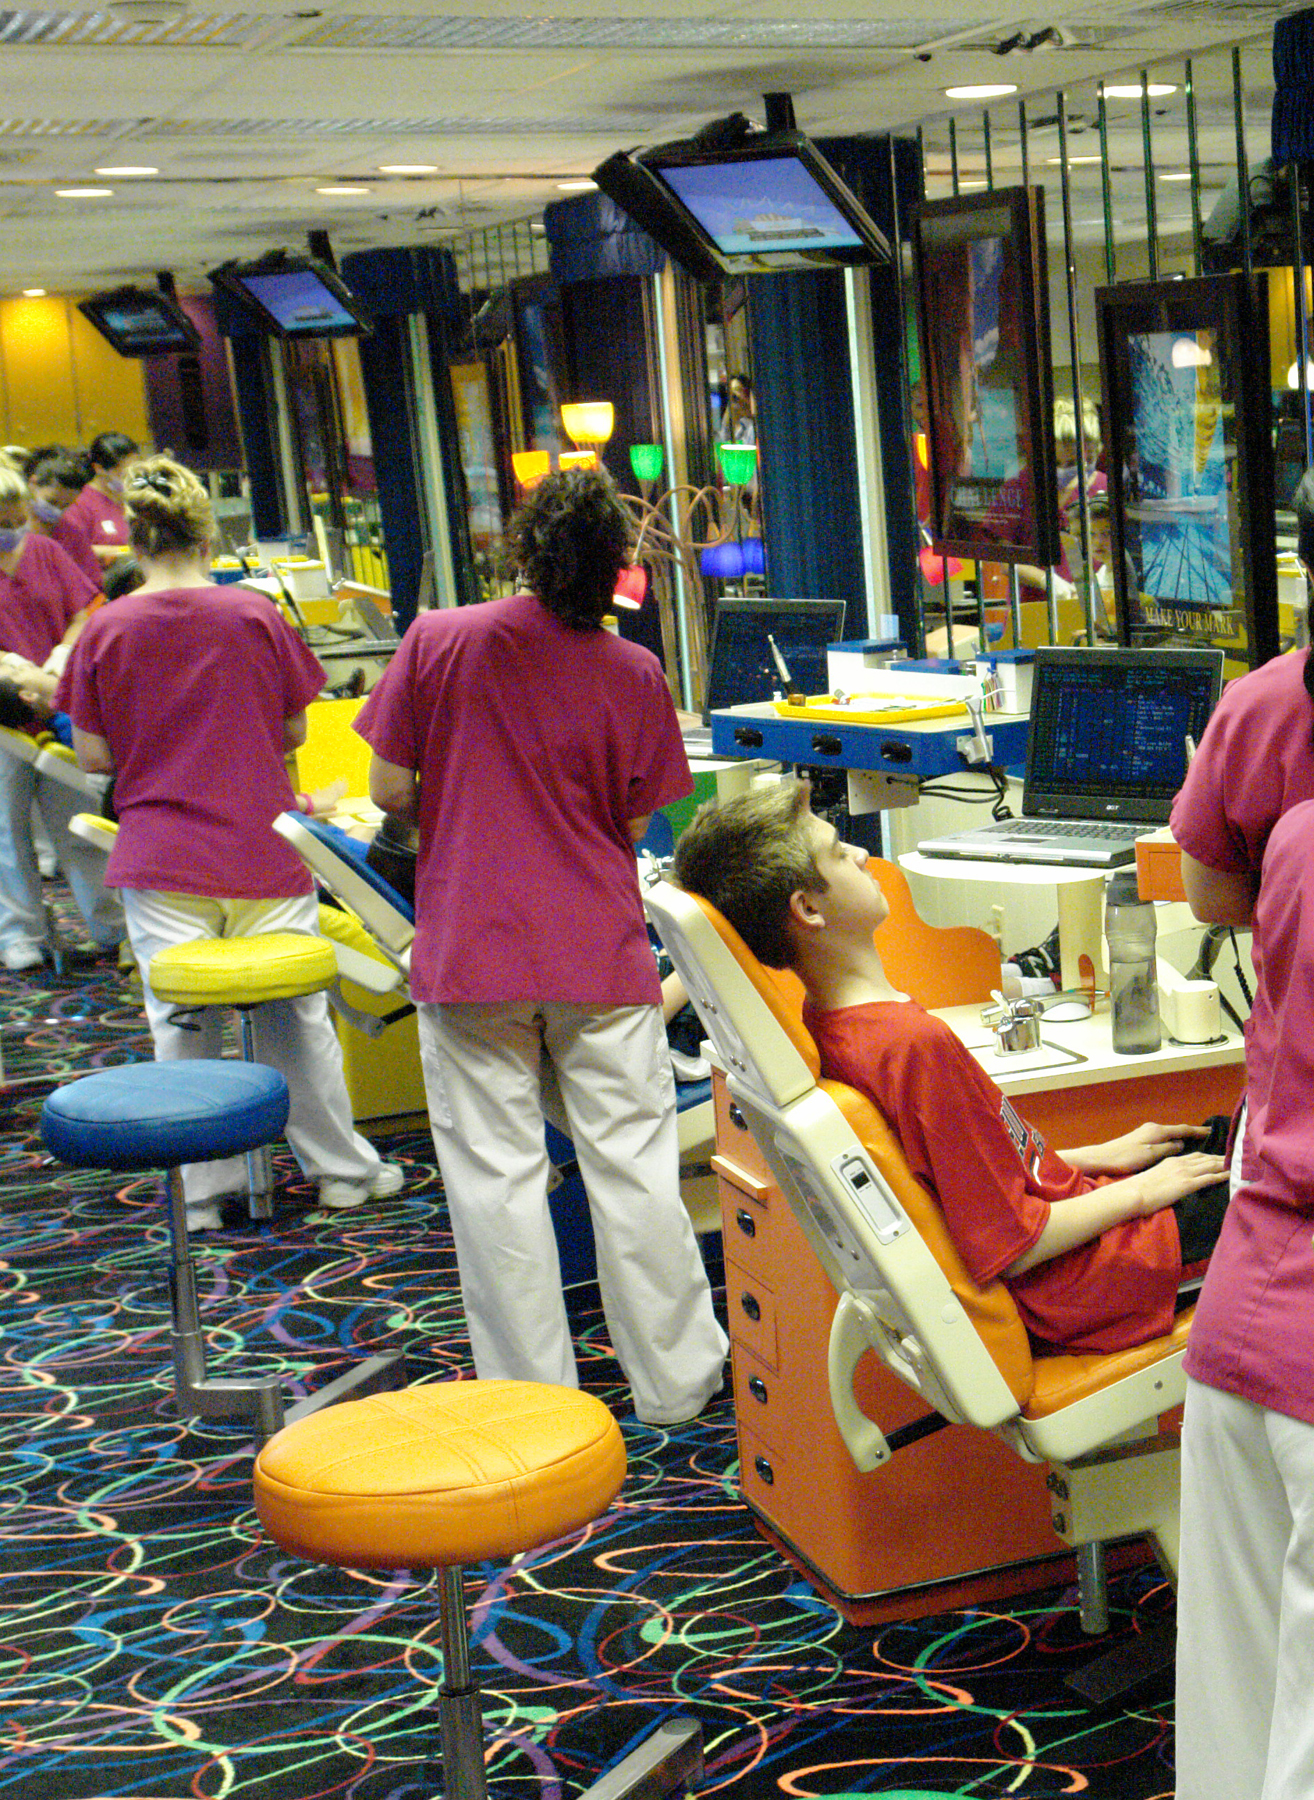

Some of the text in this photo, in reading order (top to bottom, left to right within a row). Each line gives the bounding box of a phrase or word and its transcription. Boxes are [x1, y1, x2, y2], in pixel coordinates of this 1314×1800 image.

[1145, 606, 1235, 636] MAKE YOUR MARK
